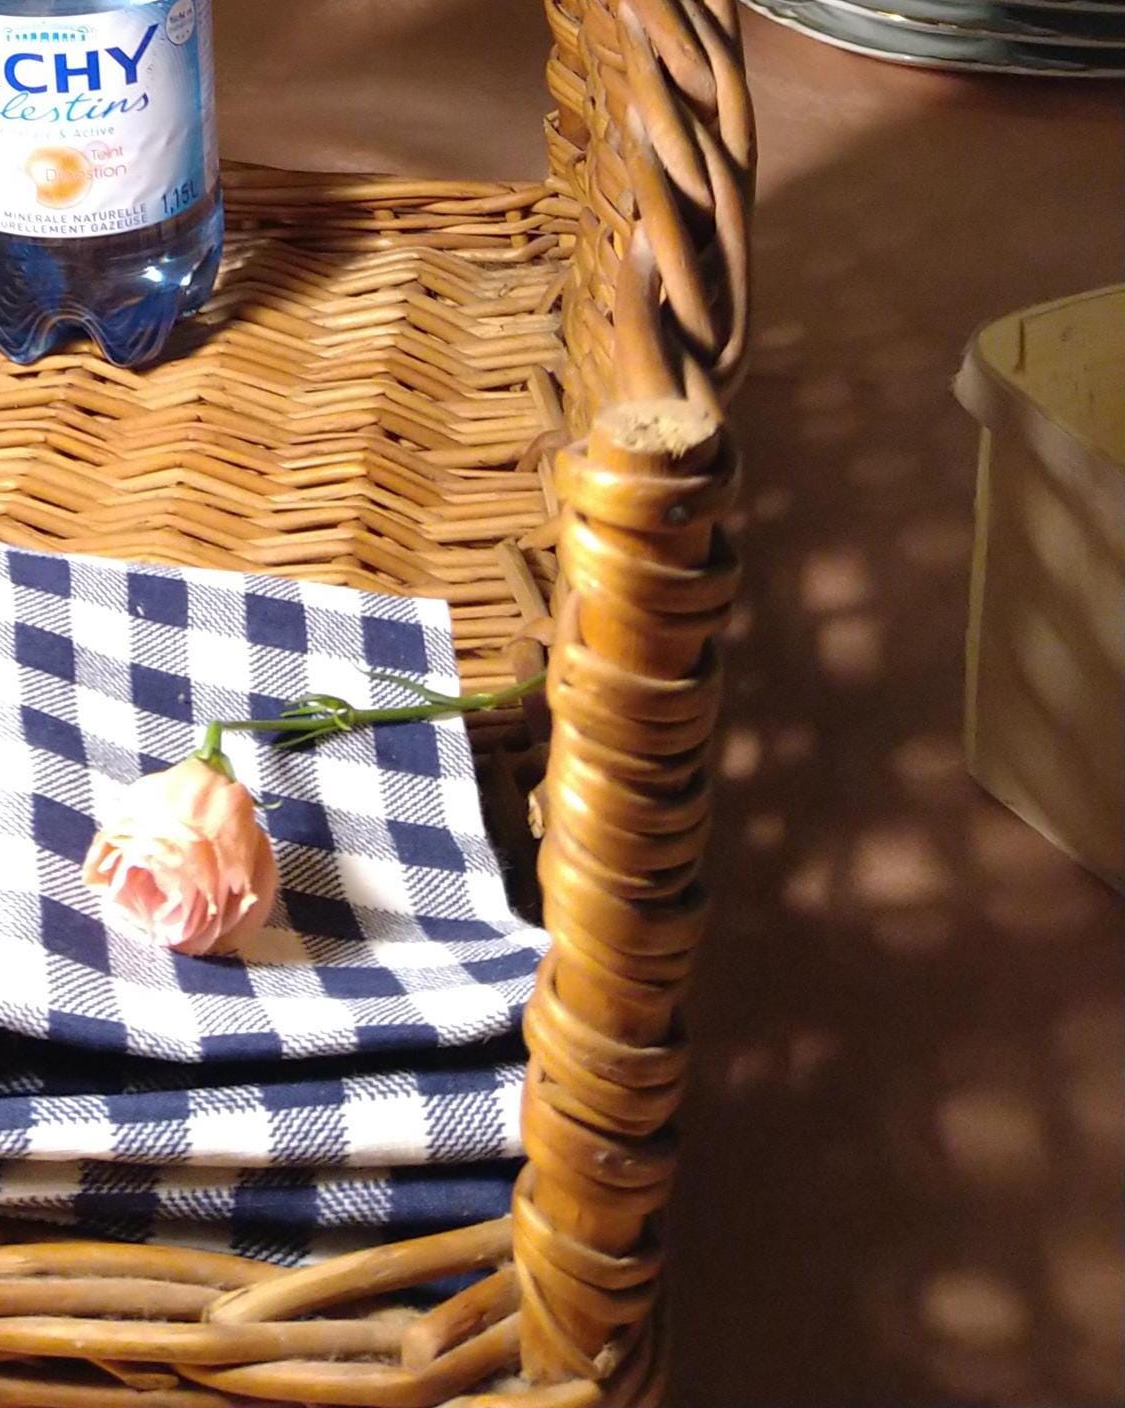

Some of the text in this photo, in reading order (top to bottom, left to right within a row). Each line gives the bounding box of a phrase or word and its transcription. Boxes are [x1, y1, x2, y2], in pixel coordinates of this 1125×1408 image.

[73, 125, 115, 138] Active
[91, 146, 124, 160] Teint
[72, 202, 148, 223] NATURELLE
[90, 213, 148, 233] GAZEUSE
